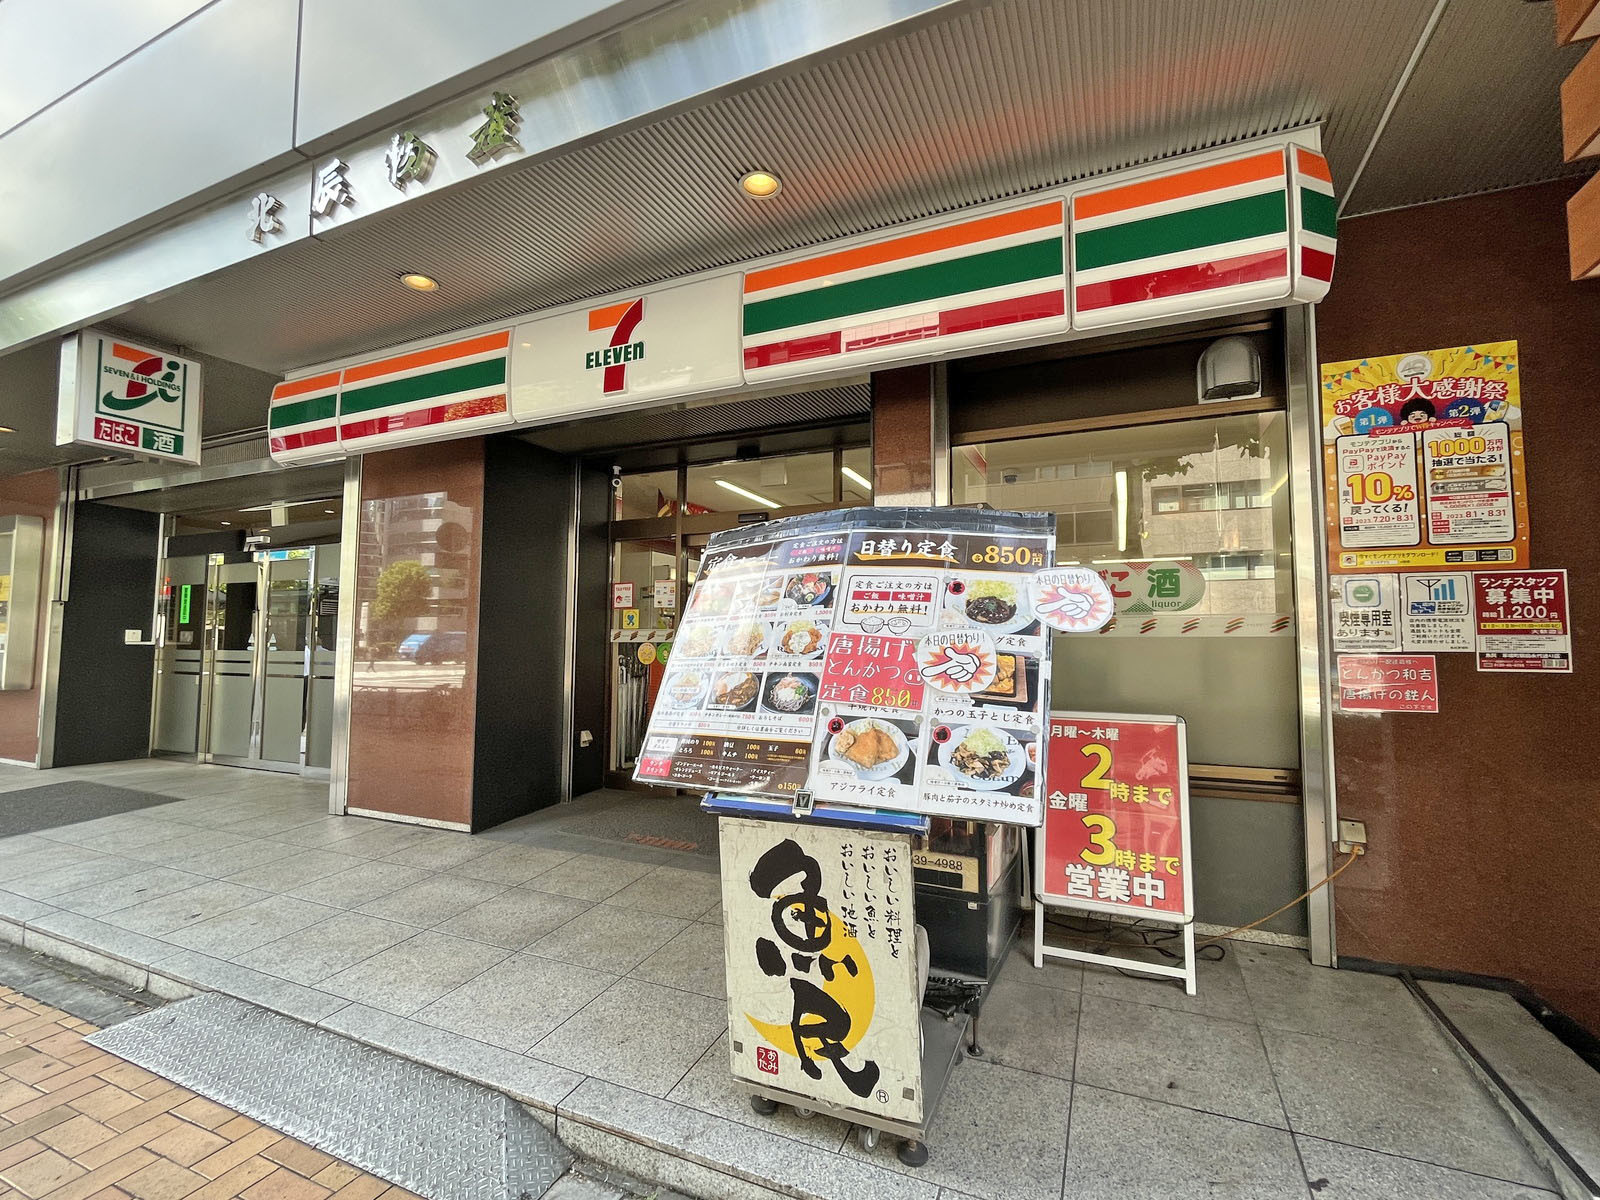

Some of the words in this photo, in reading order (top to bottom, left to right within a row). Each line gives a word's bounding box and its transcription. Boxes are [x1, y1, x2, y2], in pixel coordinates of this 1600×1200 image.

[104, 365, 130, 378] SEVEN
[141, 376, 181, 392] HOLDINGS
[1335, 377, 1507, 414] お客様大感謝祭
[1359, 415, 1388, 427] 第1弾
[1448, 405, 1481, 419] 第2弾
[99, 420, 135, 445] たばこ
[153, 431, 175, 453] 酒
[1367, 453, 1407, 463] PayPay
[1367, 461, 1406, 470] ポイント
[1347, 472, 1415, 504] 10%
[860, 538, 959, 559] 日替り定食
[855, 580, 932, 590] 定食ご注文の方は
[1147, 568, 1180, 598] 酒
[1479, 576, 1559, 588] ランチスタッフ
[1151, 600, 1182, 609] liquor
[1485, 588, 1555, 605] 募集中
[851, 603, 928, 615] おかわり無料!
[1339, 609, 1392, 627] 喫煙専用室
[1337, 628, 1384, 637] あります
[829, 635, 913, 662] 唐揚げ
[828, 658, 902, 680] とんかつ
[1342, 668, 1432, 681] とんかつ和吉
[934, 707, 1035, 725] かつの玉子とじ定食
[1050, 725, 1120, 741] 月曜～木曜
[1080, 743, 1173, 806] 2時まで
[830, 781, 896, 799] アジフライ定食
[1048, 790, 1089, 812] 金曜
[1079, 814, 1181, 876] 3時まで
[840, 843, 858, 938] おいしい地酒
[861, 845, 879, 939] おいしい魚と
[1065, 863, 1165, 907] 営業中
[883, 848, 902, 959] おいしい料理と
[750, 838, 881, 1099] 魚民
